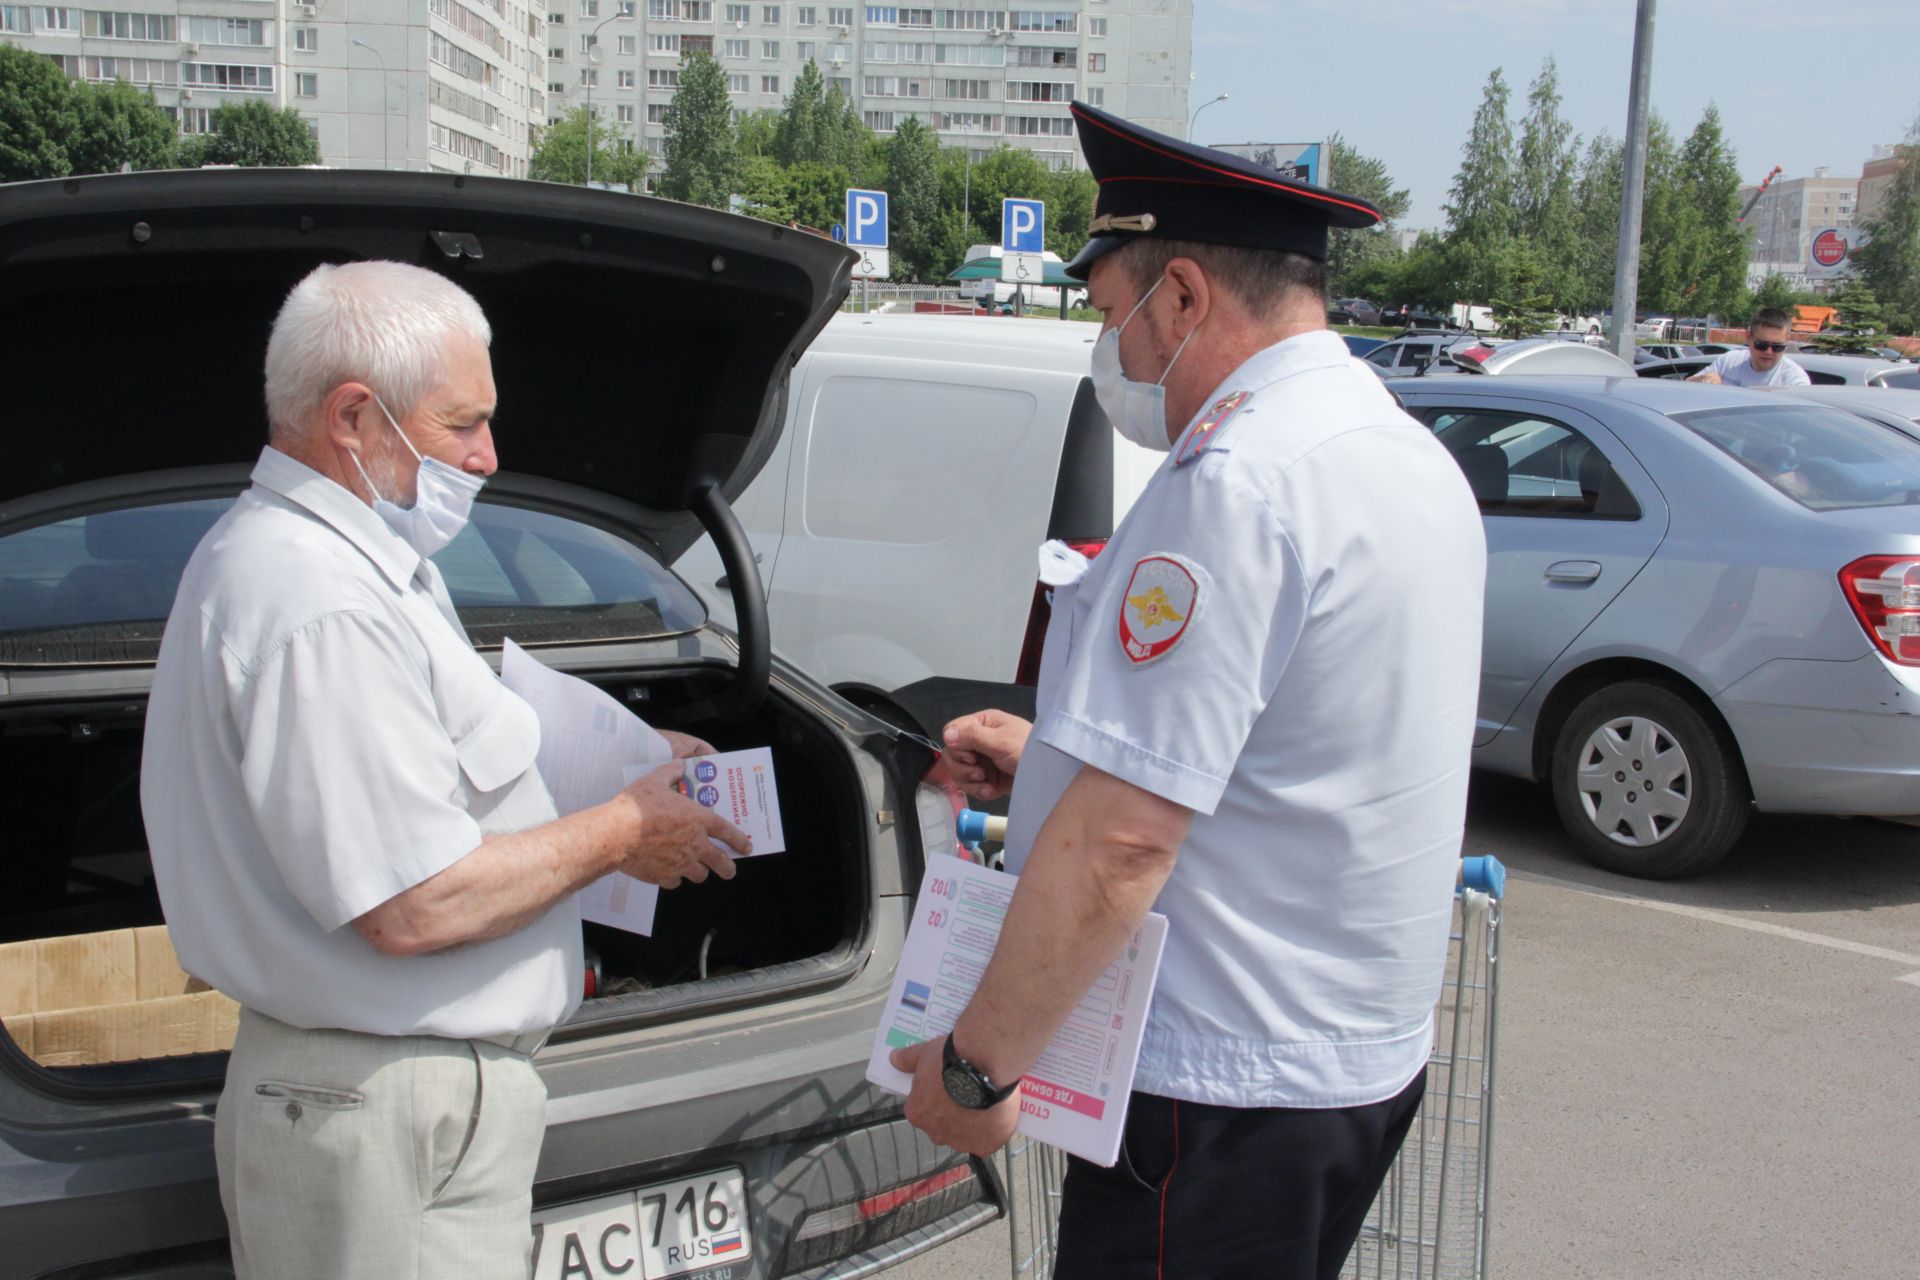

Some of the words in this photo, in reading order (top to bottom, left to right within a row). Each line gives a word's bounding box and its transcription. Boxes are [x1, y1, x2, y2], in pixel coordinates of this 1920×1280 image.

[856, 196, 879, 241] P
[1011, 205, 1035, 247] P
[727, 767, 740, 825] МОШЕННИКИ
[736, 767, 748, 817] ОСТОРОЖНО
[931, 878, 949, 896] 102
[928, 910, 942, 928] 02
[1020, 1100, 1050, 1120] СТОП
[1054, 1089, 1074, 1105] ГДЕ
[642, 1181, 728, 1247] 716
[668, 1239, 710, 1265] RUS
